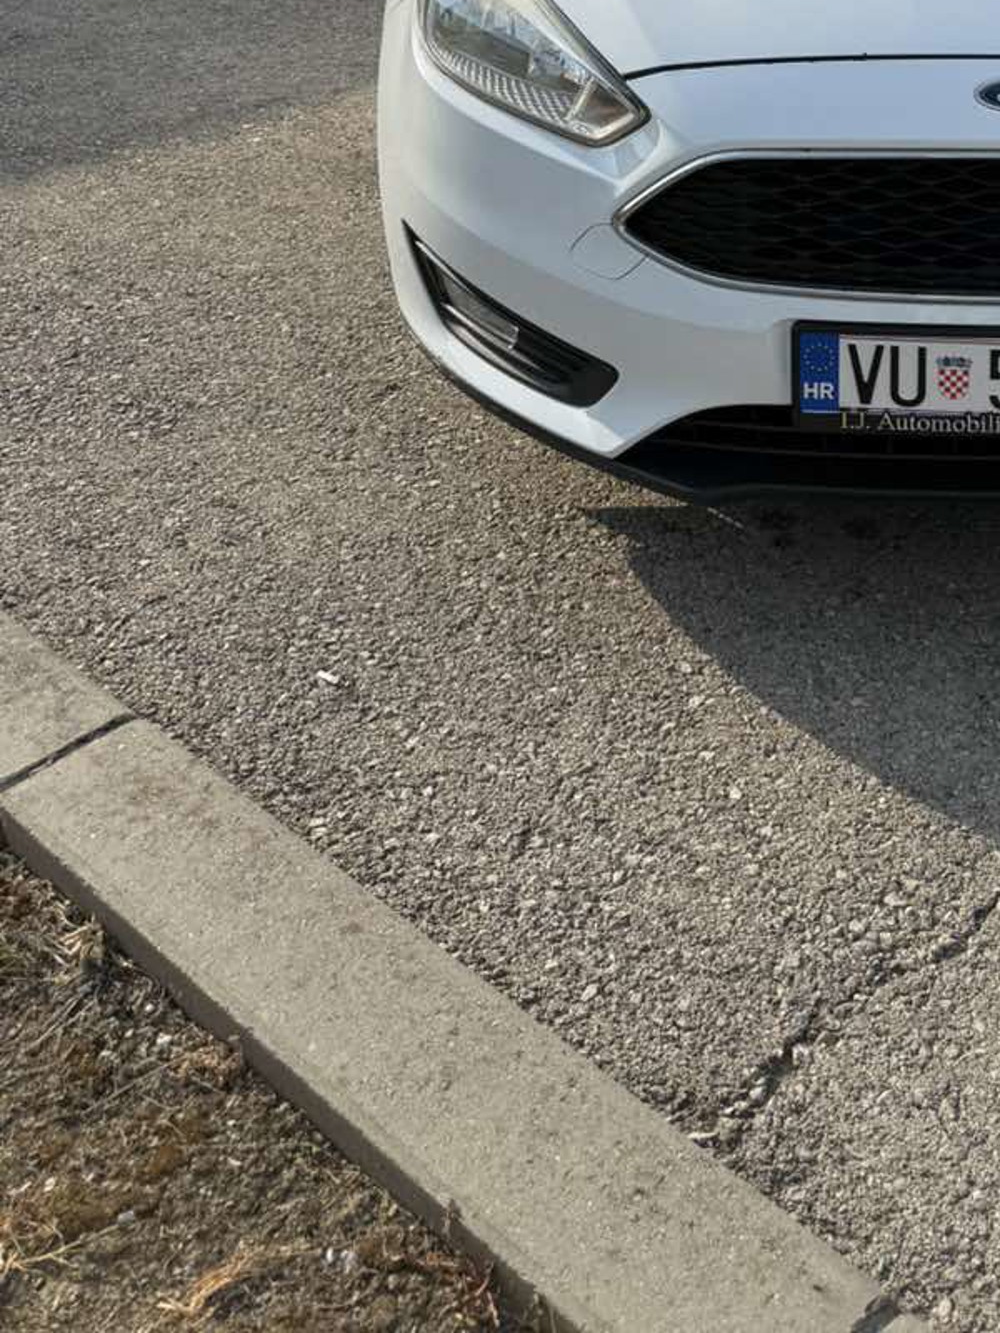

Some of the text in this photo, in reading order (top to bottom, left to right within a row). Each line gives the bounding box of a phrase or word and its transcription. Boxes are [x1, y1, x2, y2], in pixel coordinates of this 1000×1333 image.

[847, 344, 927, 407] VU
[803, 382, 834, 400] HR
[878, 411, 1000, 434] Automobili
